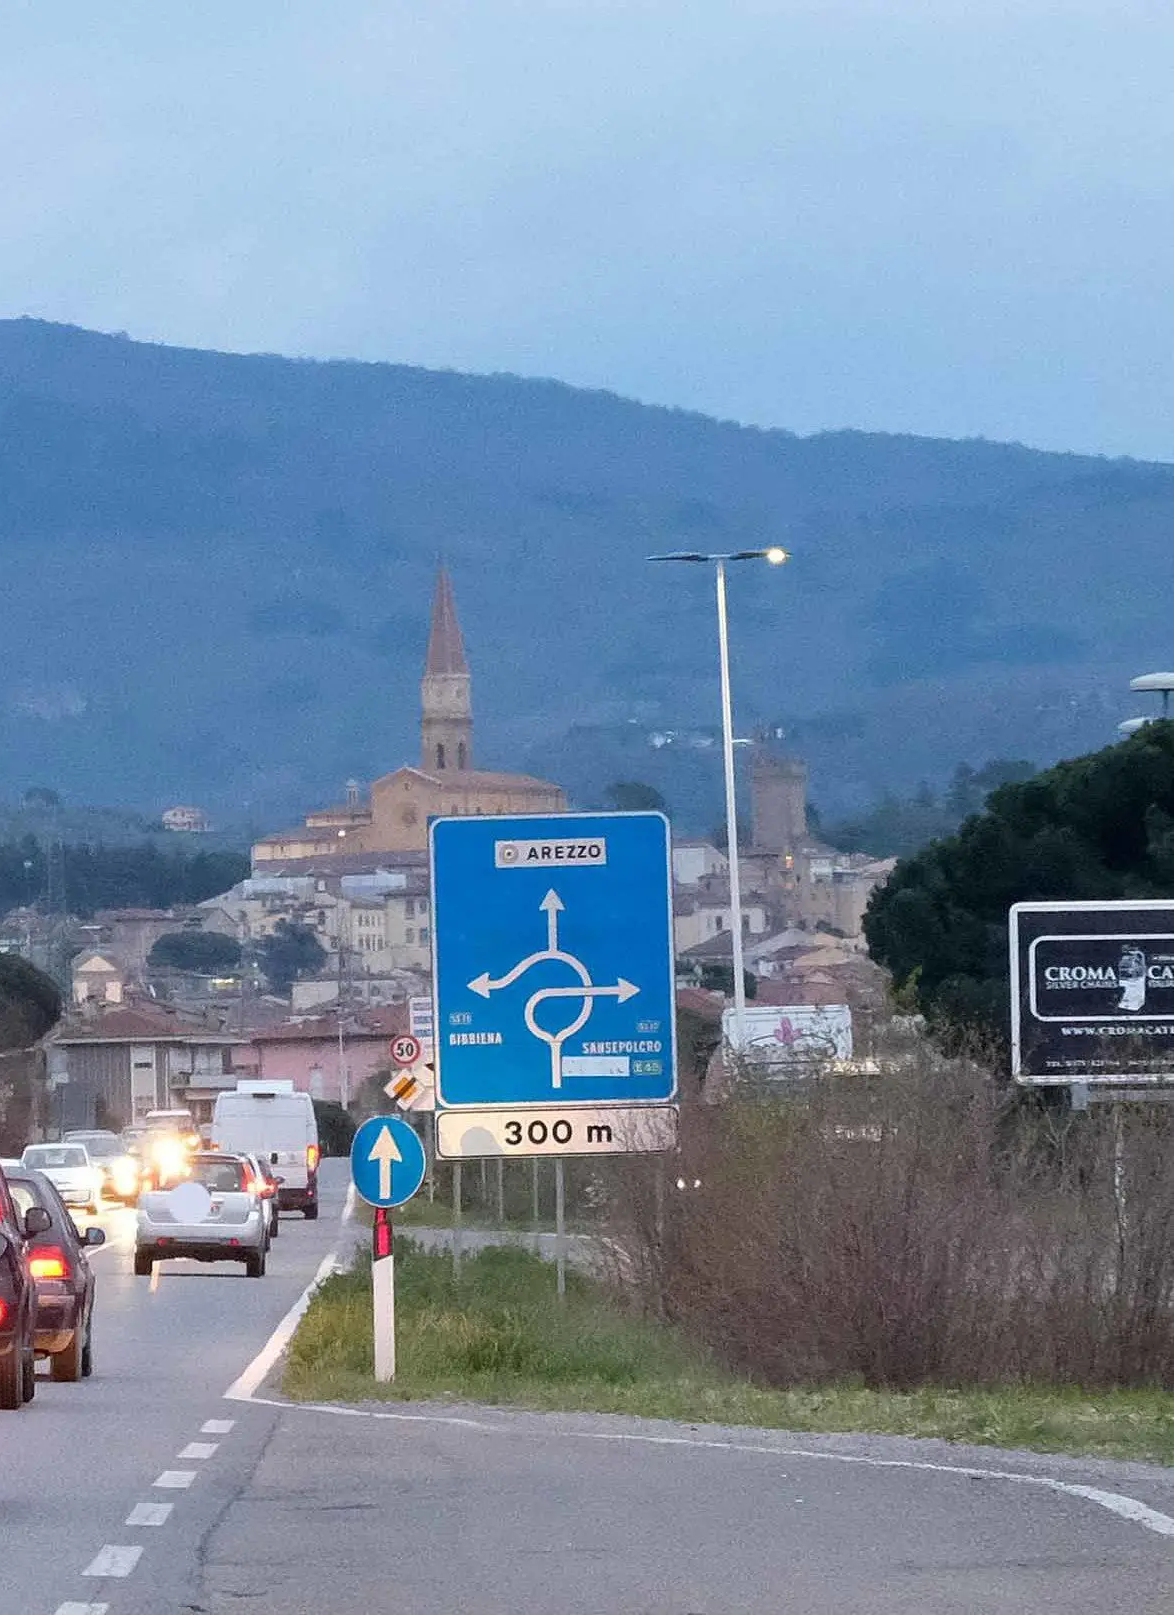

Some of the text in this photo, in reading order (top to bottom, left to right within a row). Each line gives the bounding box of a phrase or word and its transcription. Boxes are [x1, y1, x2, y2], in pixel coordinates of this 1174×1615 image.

[526, 844, 602, 861] AREZZO
[1044, 966, 1117, 981] CROMA
[1147, 965, 1174, 980] CA
[449, 1031, 503, 1046] BIBBIENA
[397, 1042, 414, 1057] 50
[581, 1040, 663, 1055] SANSEPOLCRO
[504, 1119, 613, 1145] 300 m
